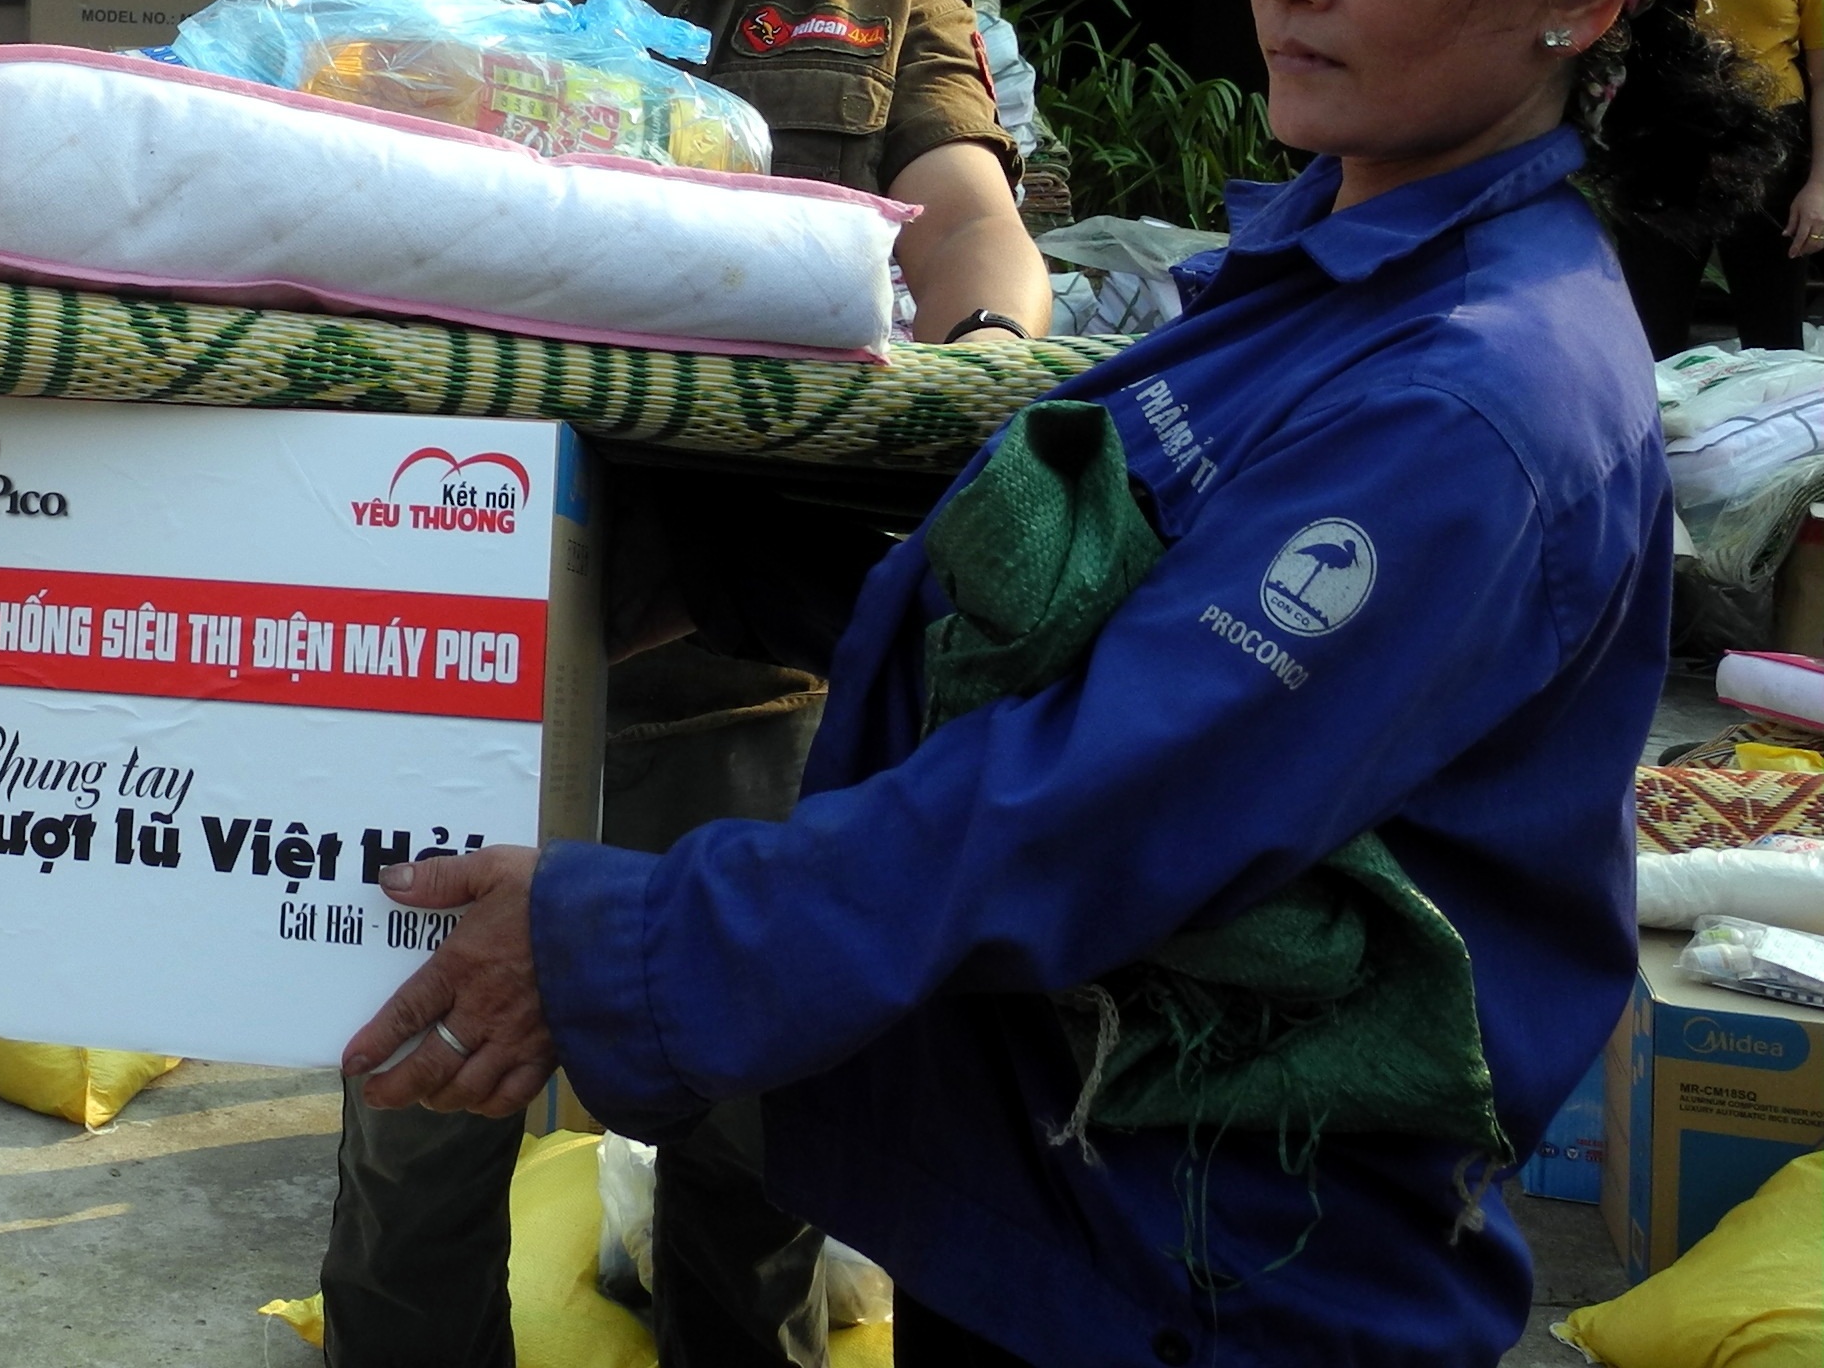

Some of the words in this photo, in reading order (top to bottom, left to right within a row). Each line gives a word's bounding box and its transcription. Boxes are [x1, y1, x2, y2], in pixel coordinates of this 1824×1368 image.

[81, 9, 138, 24] MODEL
[442, 481, 478, 509] Kết
[485, 482, 516, 510] nối
[350, 497, 400, 529] YÊU
[1269, 595, 1294, 616] CON
[101, 600, 177, 663] SIÊU
[188, 613, 242, 678] THỊ
[252, 610, 334, 683] ĐIỆN
[344, 617, 427, 678] MÁY
[434, 627, 521, 685] PICO
[121, 746, 195, 818] tay
[115, 806, 181, 869] lũ
[200, 815, 343, 894] Việt
[278, 900, 319, 944] Cát
[325, 905, 363, 947] Hải
[386, 908, 463, 951] 08/20
[1696, 1024, 1784, 1058] Midea
[1679, 1082, 1758, 1102] MR-CM18SQ
[1716, 1108, 1766, 1122] AUTOMATIC
